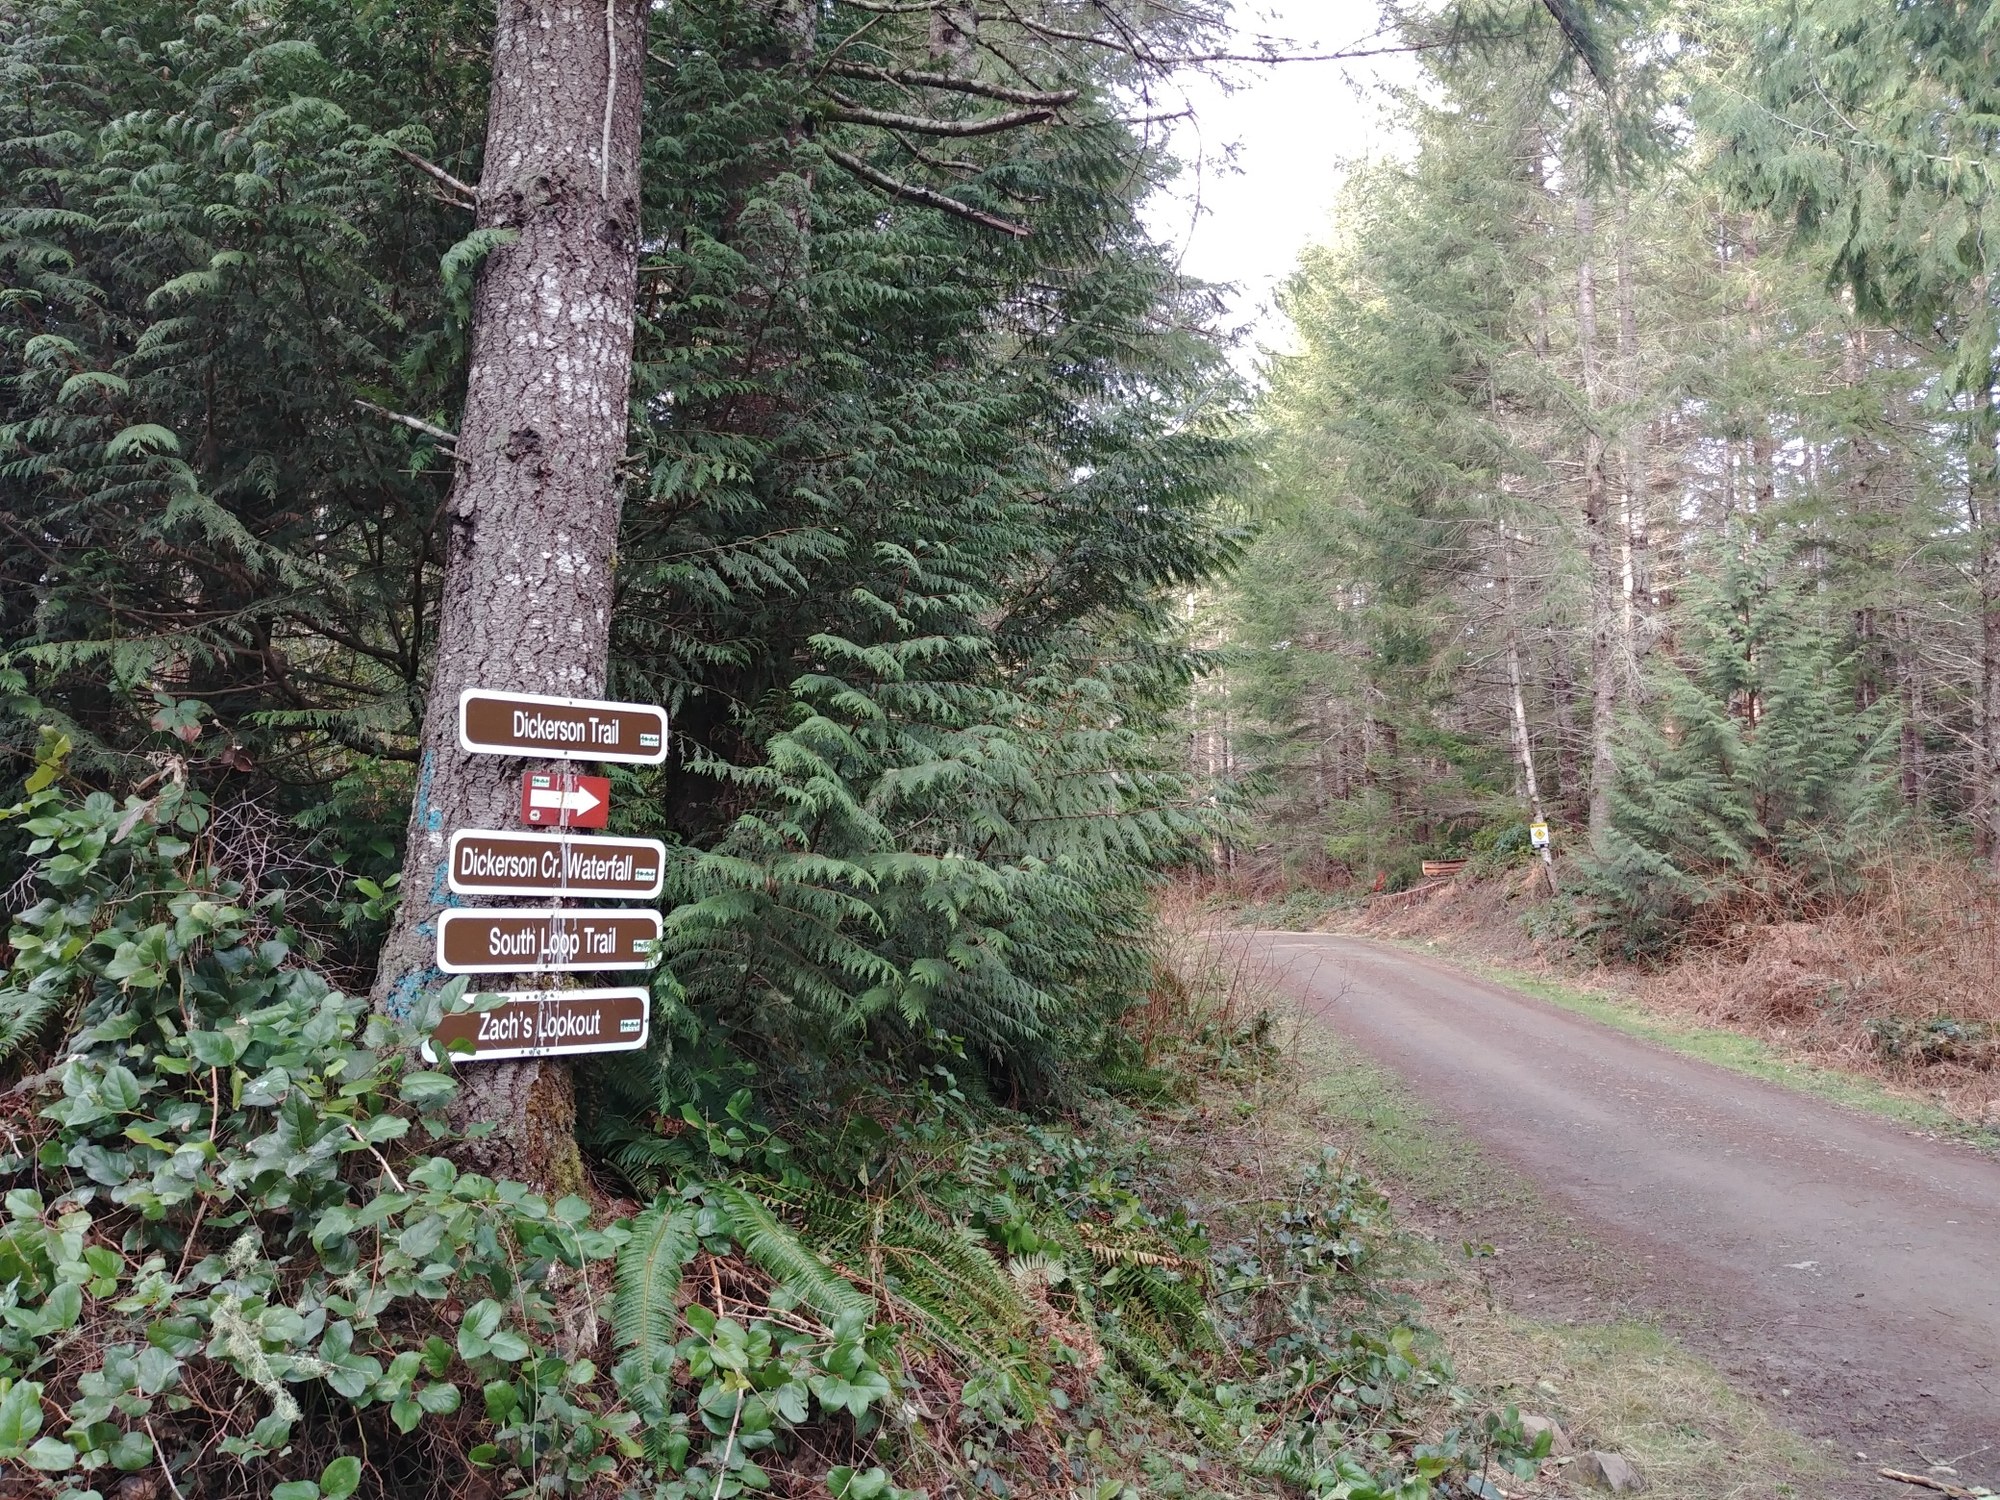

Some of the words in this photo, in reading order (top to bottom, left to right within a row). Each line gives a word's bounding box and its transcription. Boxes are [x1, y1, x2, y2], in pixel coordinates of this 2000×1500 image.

[513, 711, 585, 742] Dickerson
[588, 717, 620, 744] Trail
[461, 847, 537, 878] Dickerson
[541, 851, 561, 878] Cr.
[567, 853, 633, 881] Waterfall
[489, 927, 536, 956] South
[541, 927, 580, 960] Loop
[584, 927, 617, 954] Trail
[478, 1011, 533, 1041] Zach's
[539, 1009, 601, 1039] Lookout
